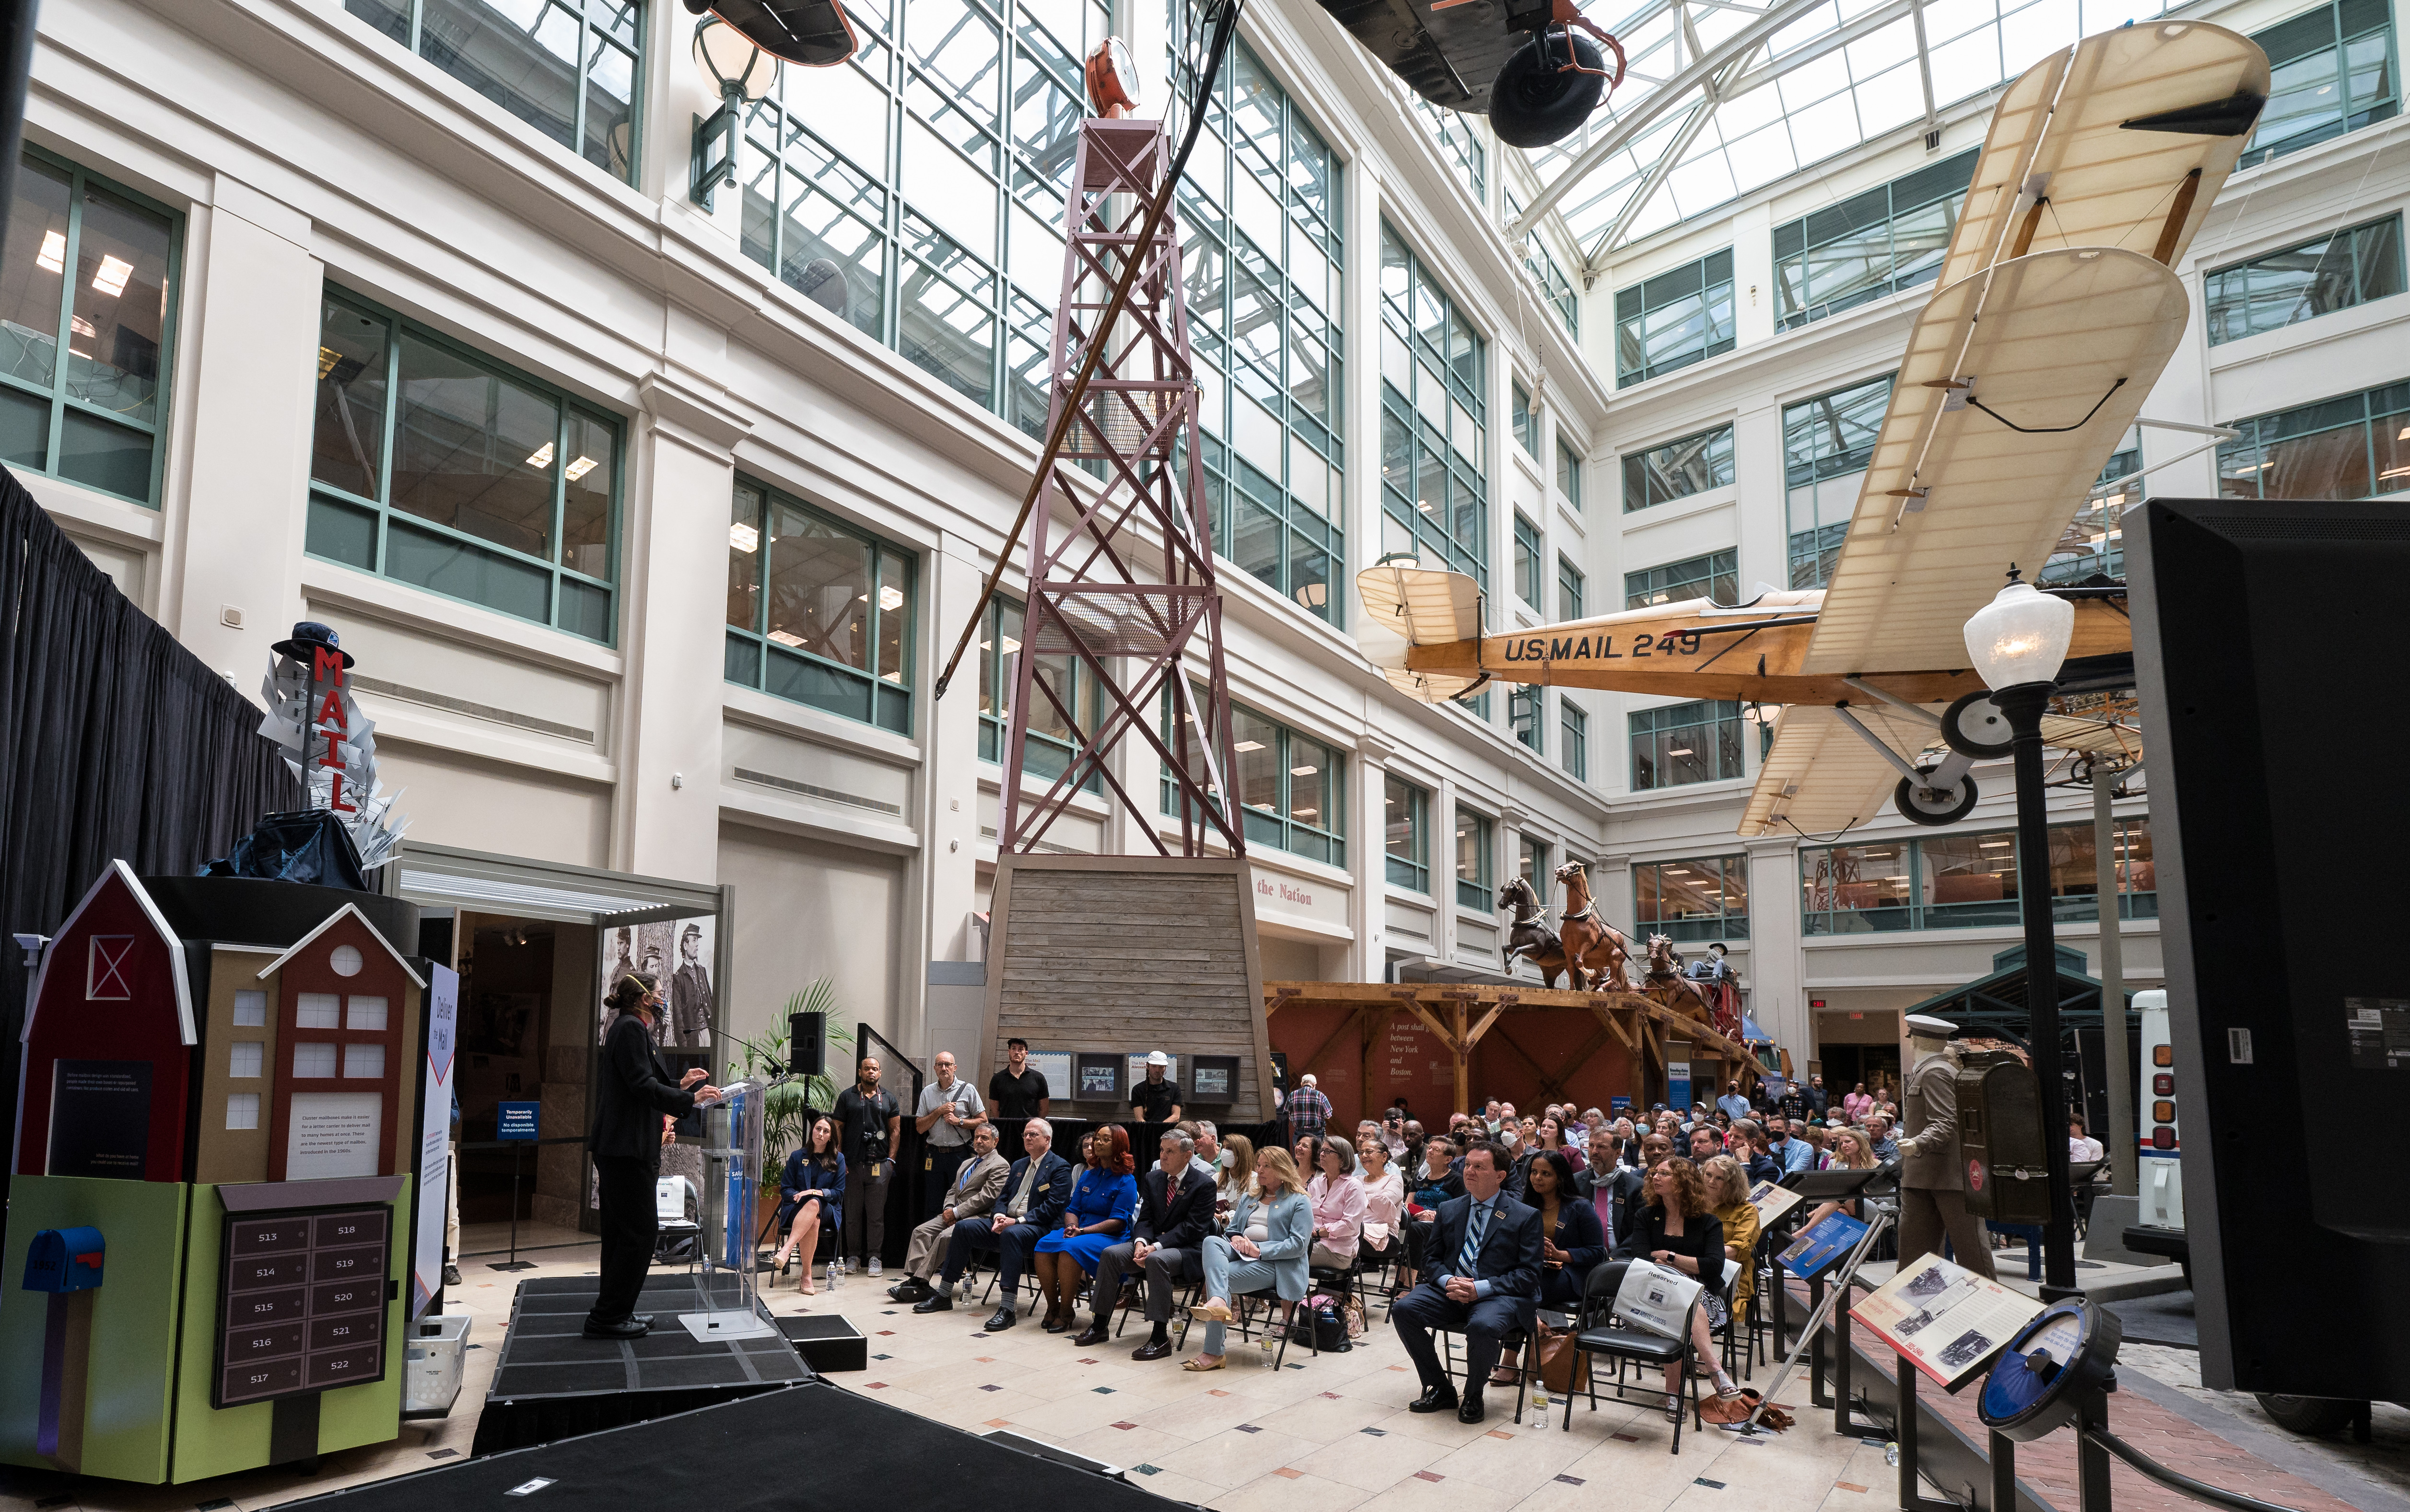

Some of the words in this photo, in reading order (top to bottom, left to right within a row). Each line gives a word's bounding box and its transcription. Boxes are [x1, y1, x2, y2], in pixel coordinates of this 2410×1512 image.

[1632, 634, 1701, 657] 249
[314, 646, 356, 812] MAIL
[1257, 879, 1274, 896] the
[1280, 883, 1311, 905] Nation
[437, 996, 452, 1020] Deliver
[438, 1028, 447, 1050] Mail
[33, 1260, 56, 1271] 1952
[337, 1260, 353, 1268] 519
[257, 1268, 274, 1277] 514
[1648, 1271, 1678, 1285] Reserved
[335, 1293, 352, 1301] 520
[255, 1303, 273, 1312] 515
[333, 1327, 350, 1336] 521
[253, 1339, 271, 1348] 516
[331, 1361, 349, 1370] 522
[251, 1374, 268, 1383] 517
